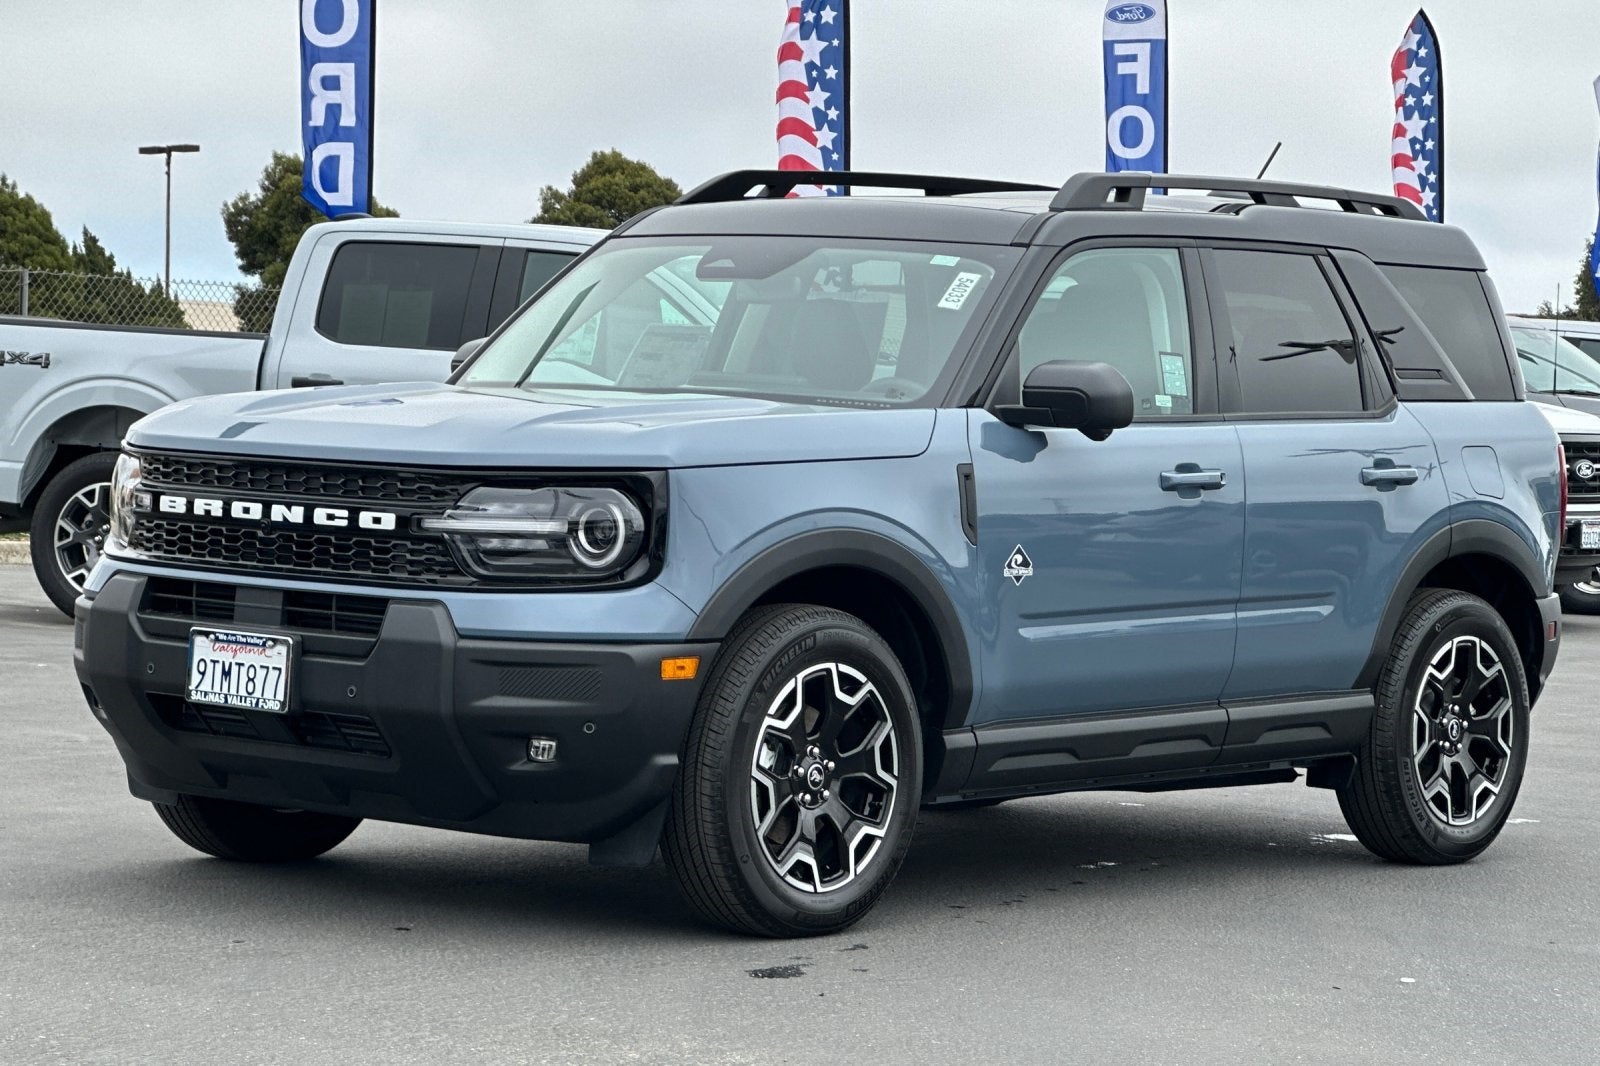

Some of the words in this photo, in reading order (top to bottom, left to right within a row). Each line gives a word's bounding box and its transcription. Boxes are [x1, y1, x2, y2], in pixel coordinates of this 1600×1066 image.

[945, 277, 974, 303] 54033
[159, 495, 396, 530] BRONCO
[211, 641, 272, 659] California
[227, 634, 236, 642] Are
[236, 635, 247, 643] The
[195, 657, 282, 699] 9TMT877
[762, 635, 815, 691] MICHELIN
[191, 690, 225, 704] SALINAS
[227, 694, 257, 707] VALLEY
[258, 698, 280, 710] FORD
[1402, 760, 1426, 822] MICHELIN
